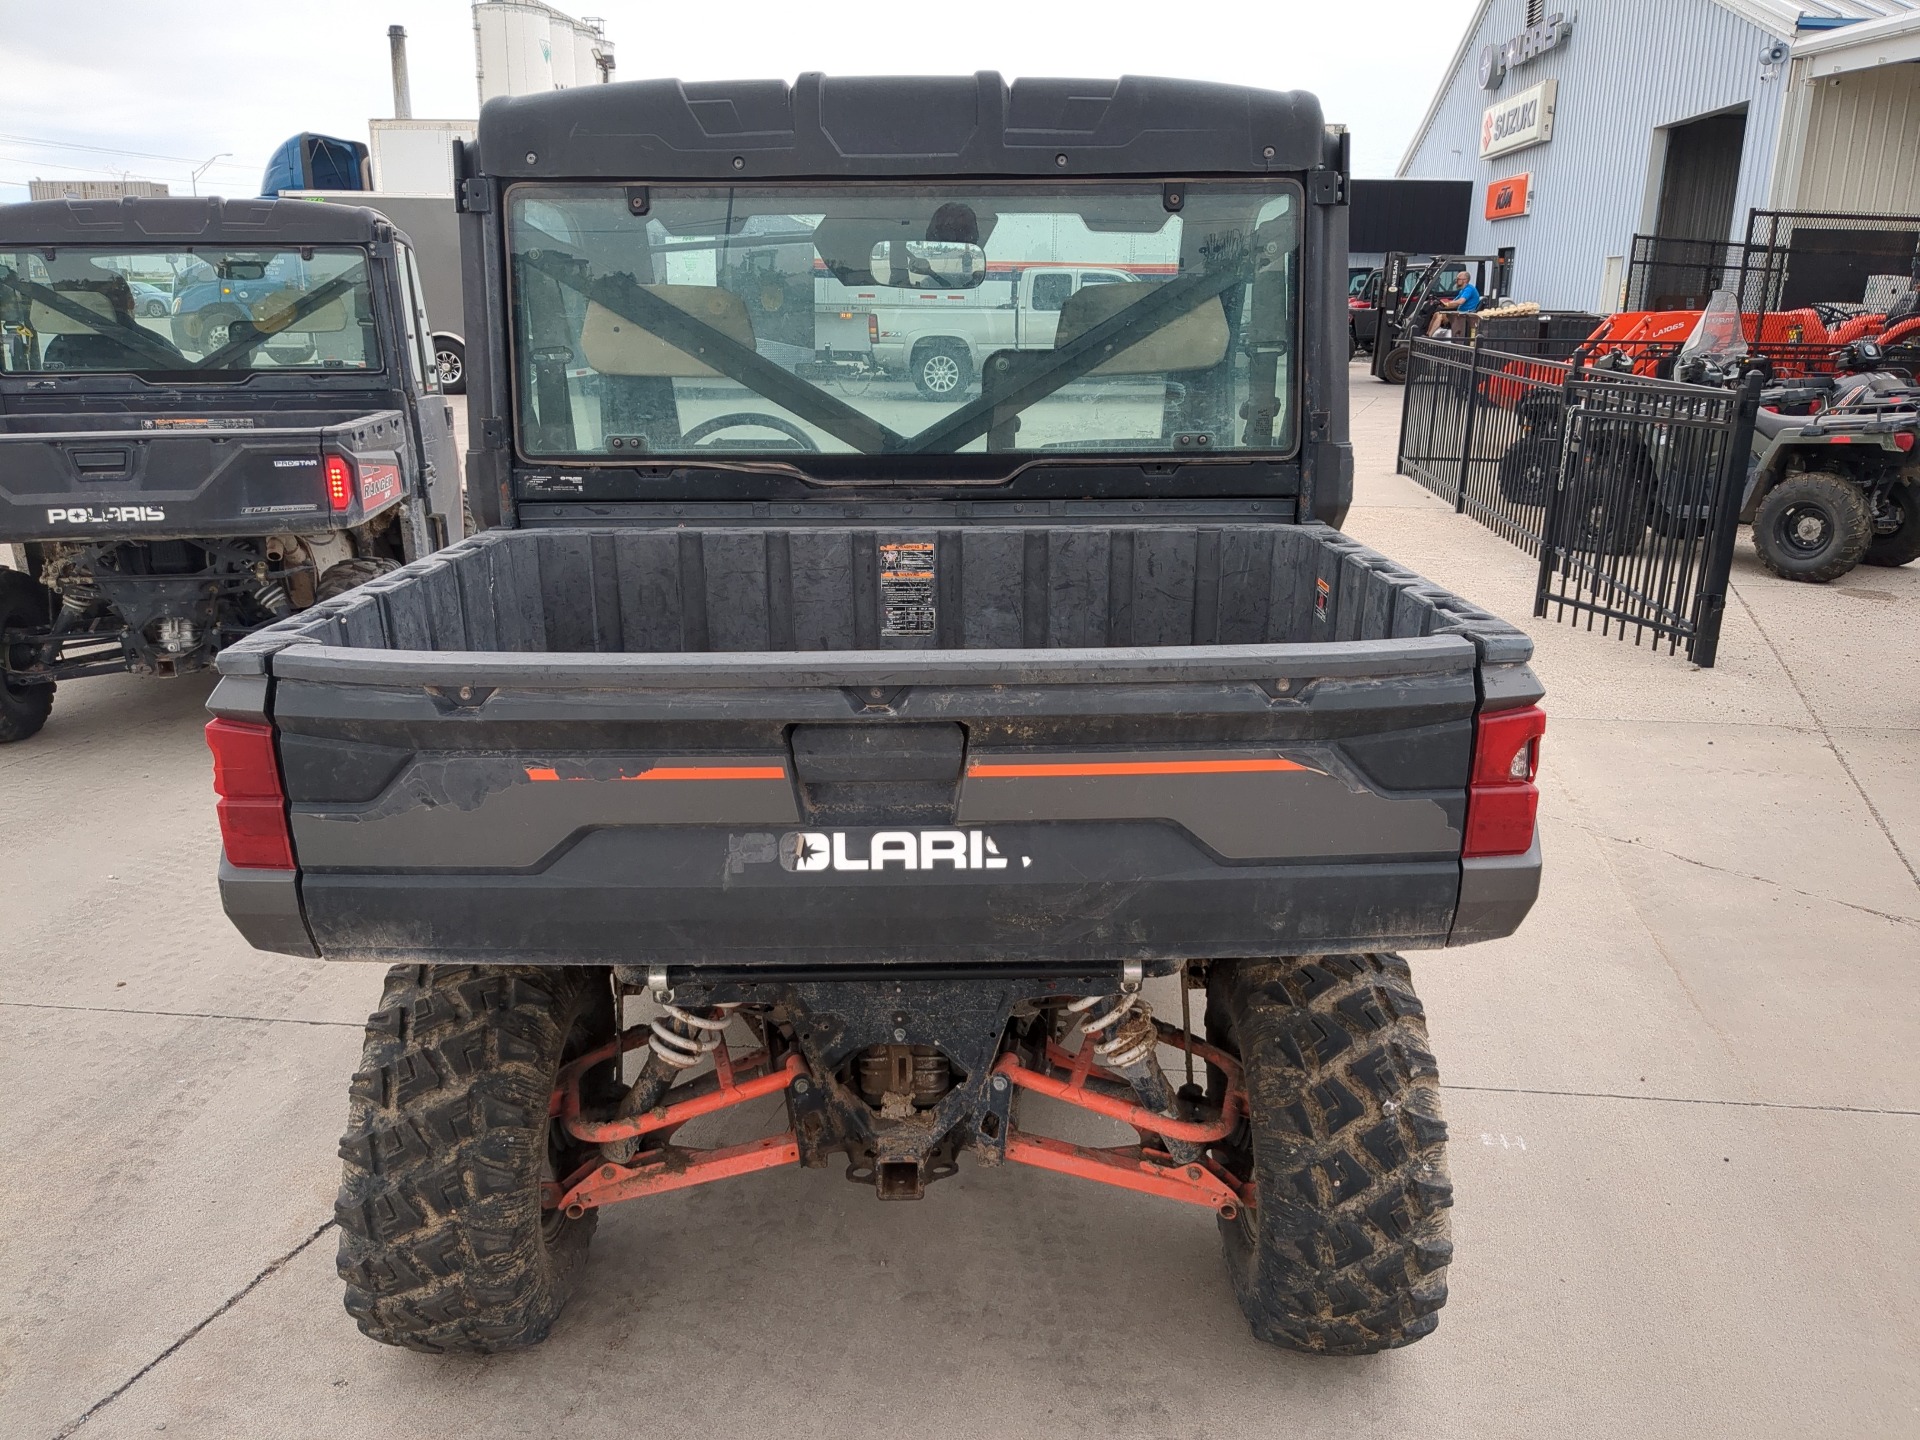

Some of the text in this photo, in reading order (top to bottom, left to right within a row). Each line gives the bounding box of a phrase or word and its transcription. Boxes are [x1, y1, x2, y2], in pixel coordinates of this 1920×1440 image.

[1497, 13, 1564, 76] POLARIS
[1494, 99, 1538, 142] SUZUKI
[1495, 185, 1514, 211] KTM
[1391, 259, 1399, 287] NISSAN
[1652, 321, 1685, 338] LA1065
[363, 473, 394, 500] RANGER
[47, 506, 165, 524] POLARIS
